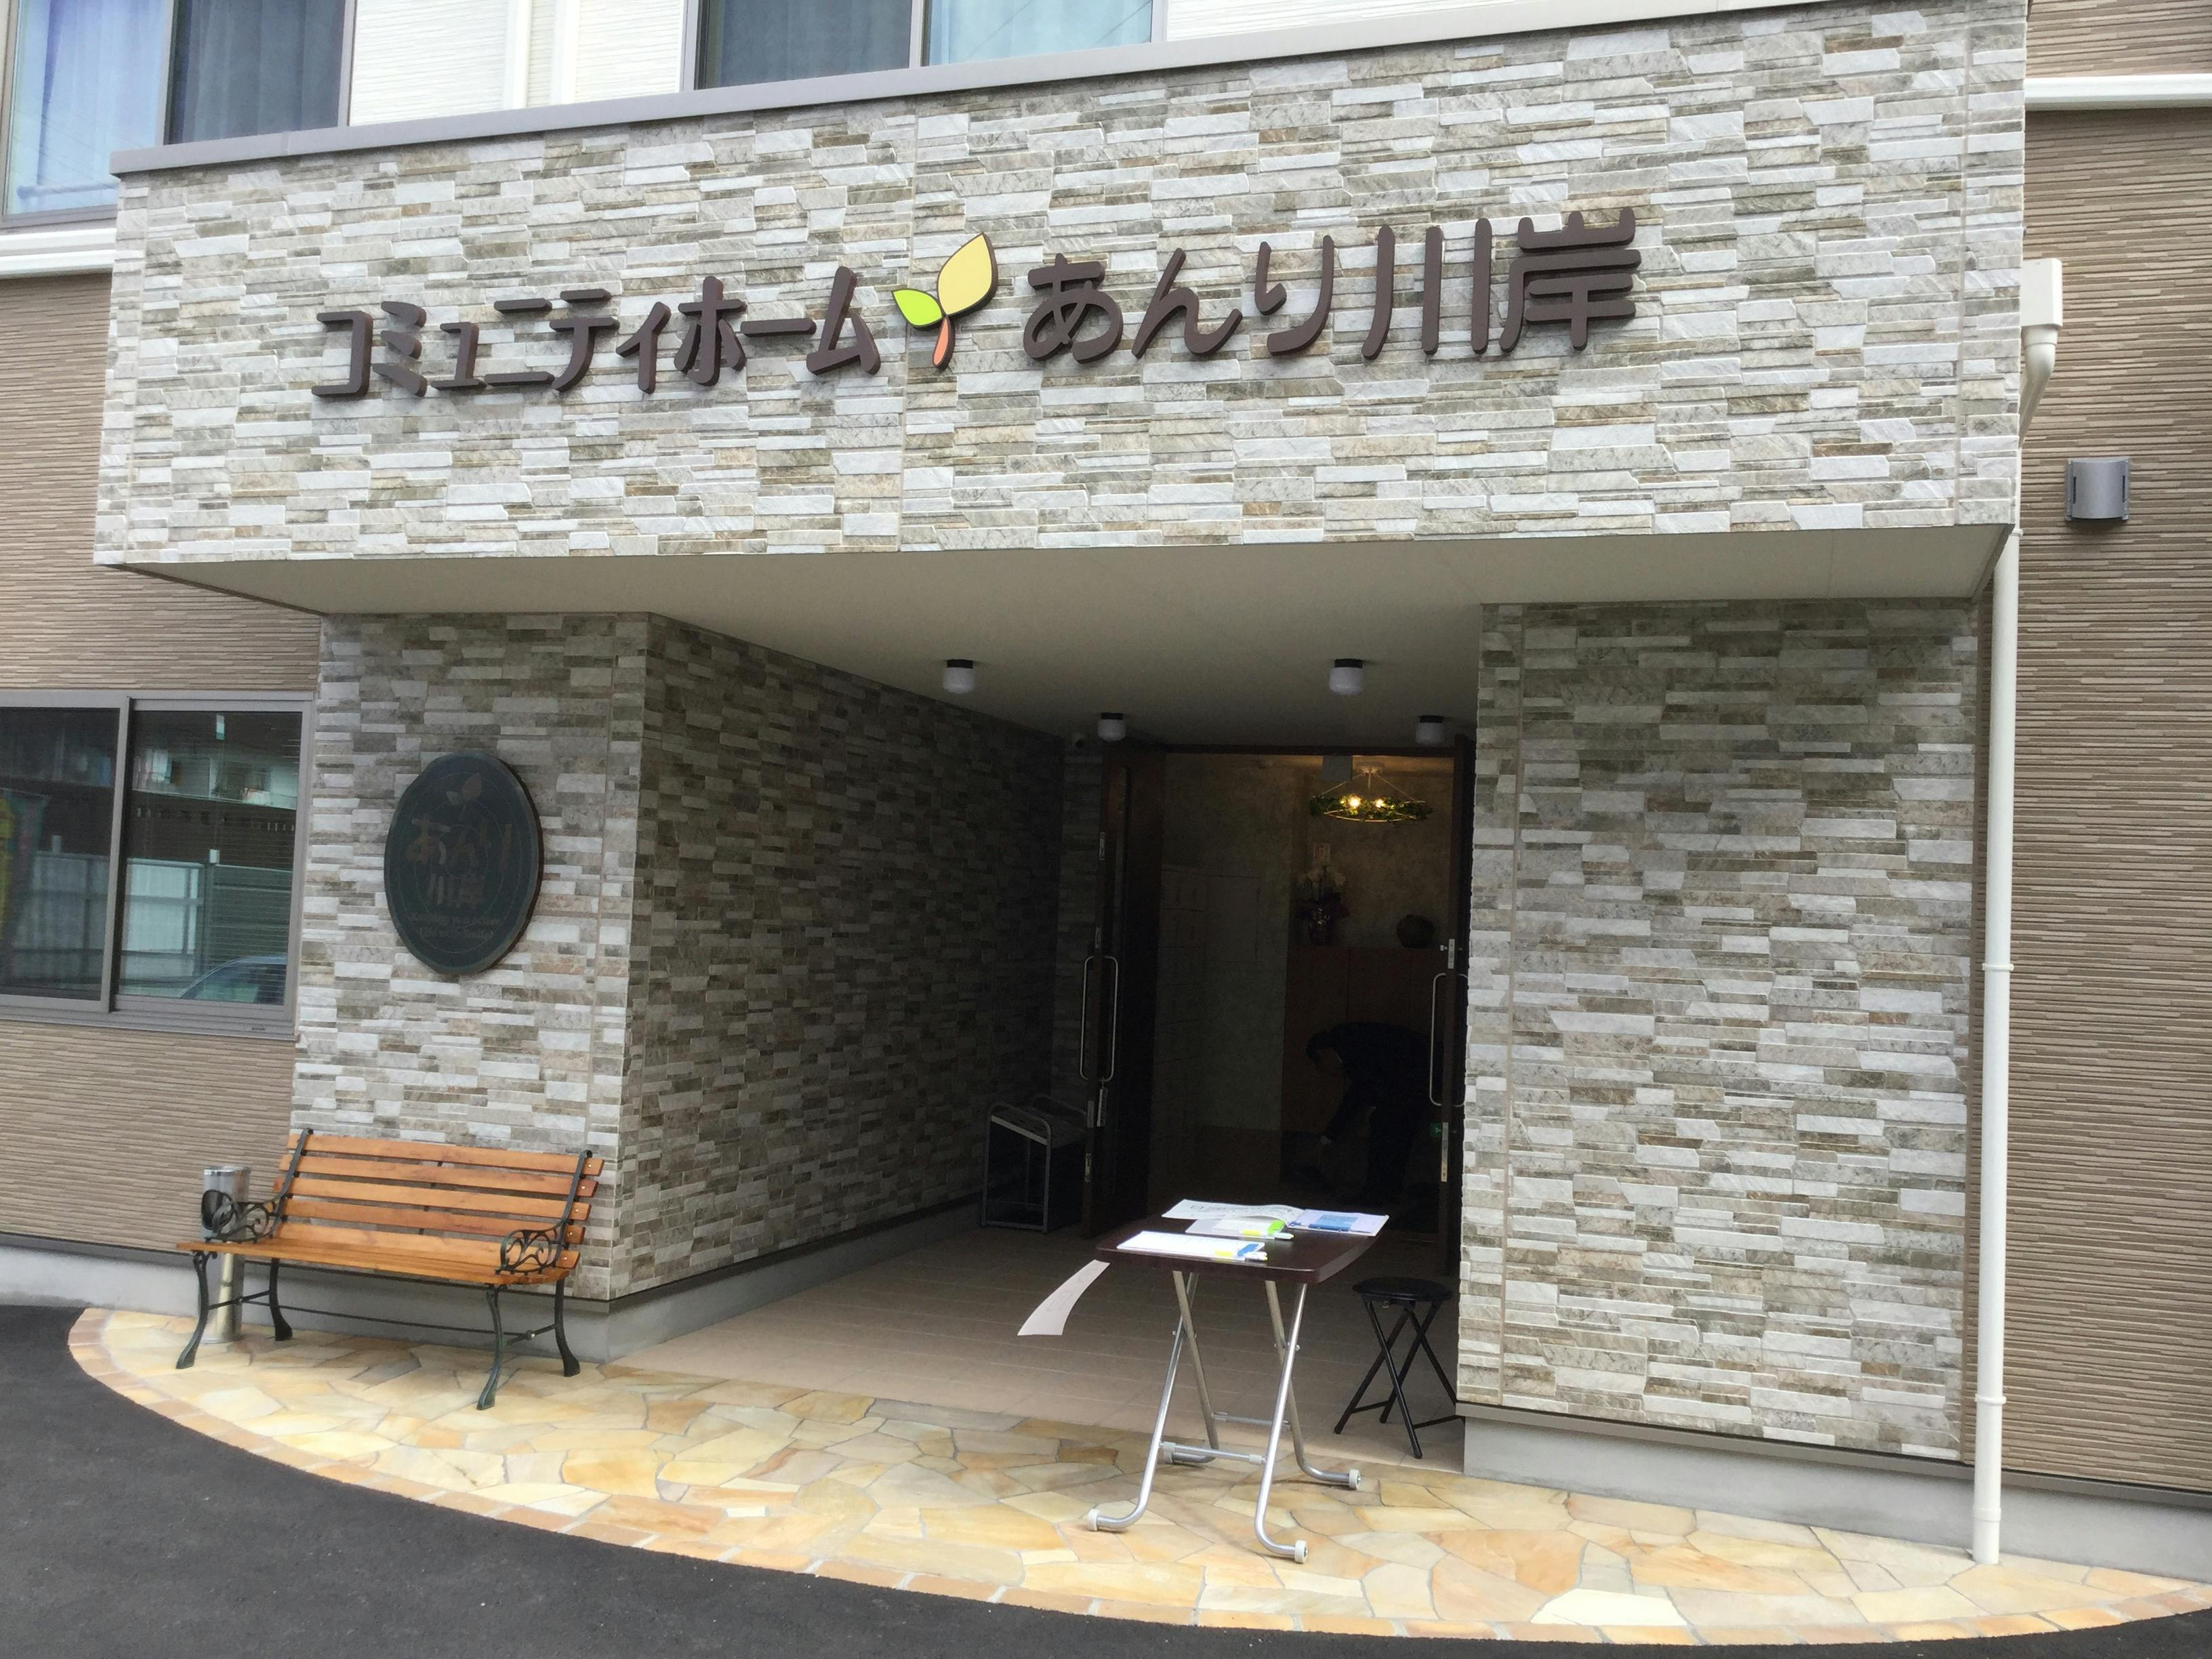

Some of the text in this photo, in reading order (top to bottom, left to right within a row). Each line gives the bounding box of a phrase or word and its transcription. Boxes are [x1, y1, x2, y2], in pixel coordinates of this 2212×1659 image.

[311, 206, 1642, 398] コミュニティホーム あんり川岸
